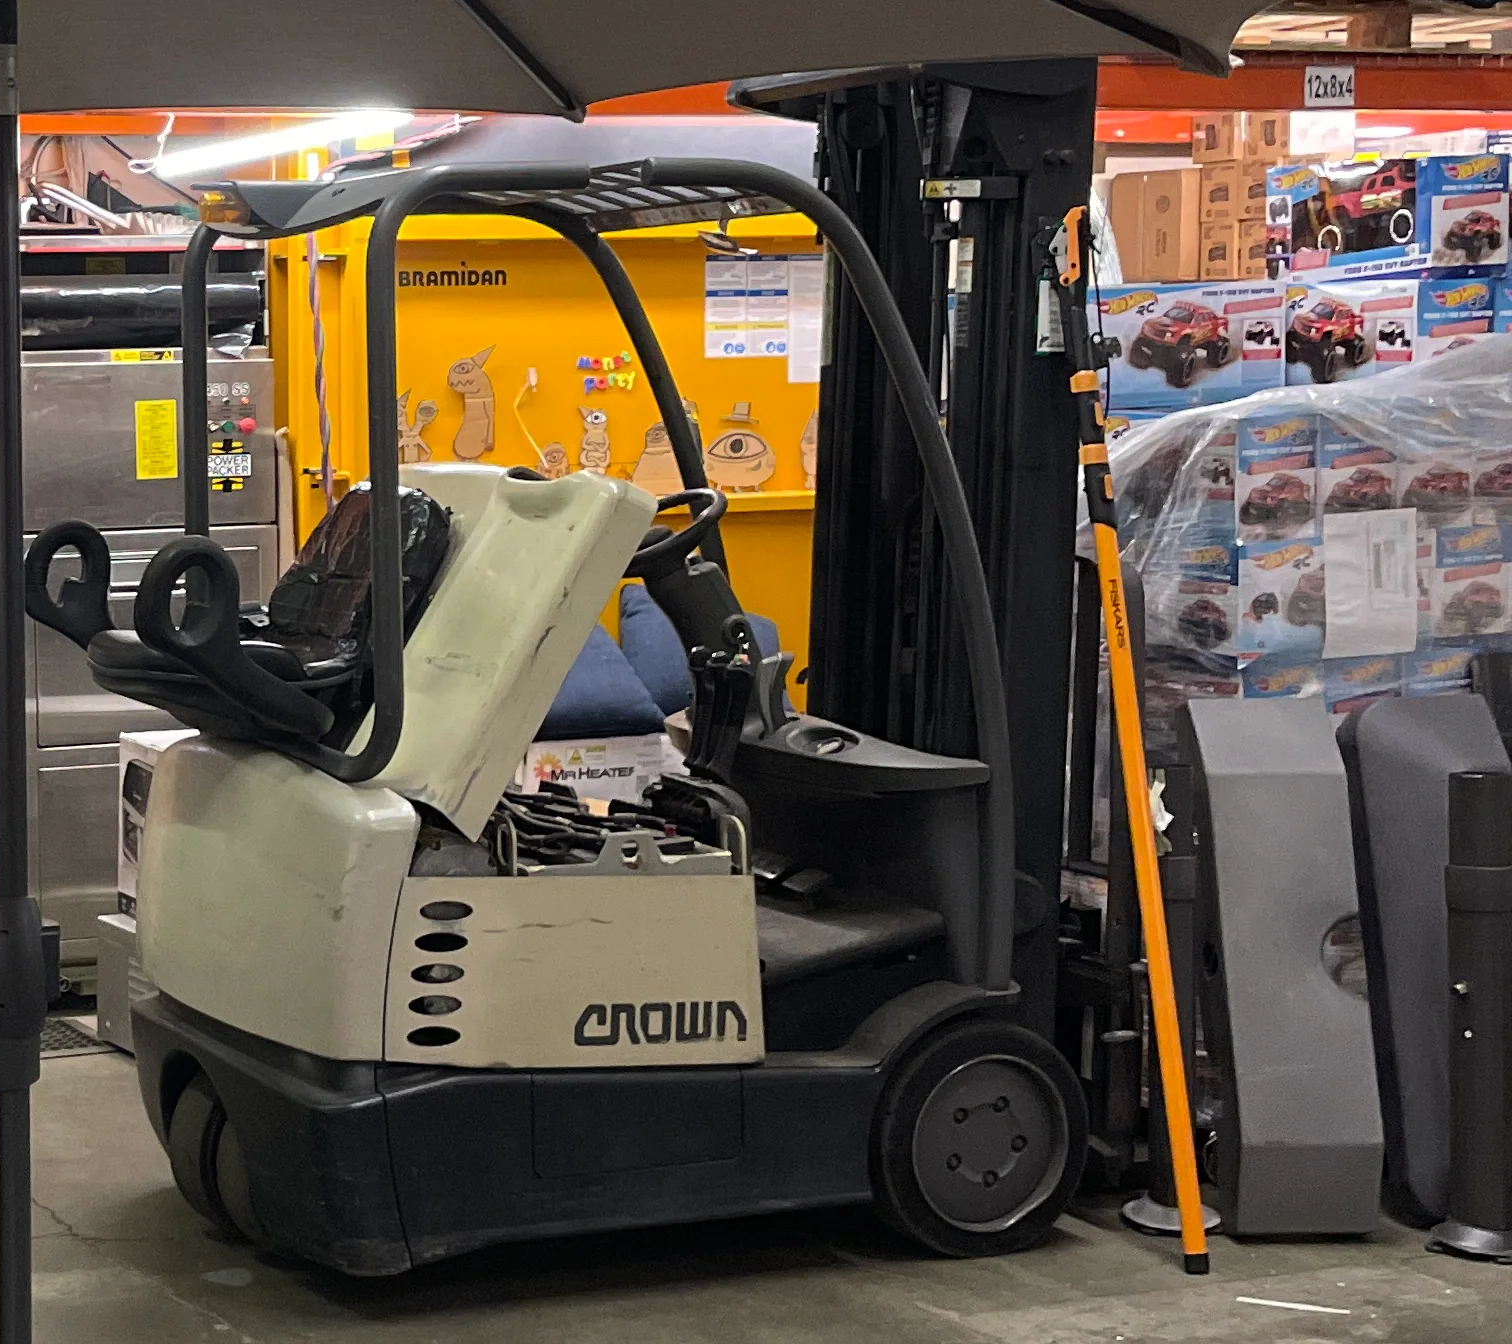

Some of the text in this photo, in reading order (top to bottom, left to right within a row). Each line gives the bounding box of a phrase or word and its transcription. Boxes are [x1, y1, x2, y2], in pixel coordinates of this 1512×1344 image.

[1307, 74, 1354, 99] 12x8x4
[207, 455, 249, 466] POWER
[207, 465, 249, 475] PACKER
[1107, 578, 1126, 649] FISKARS
[574, 1001, 747, 1046] CROWN
